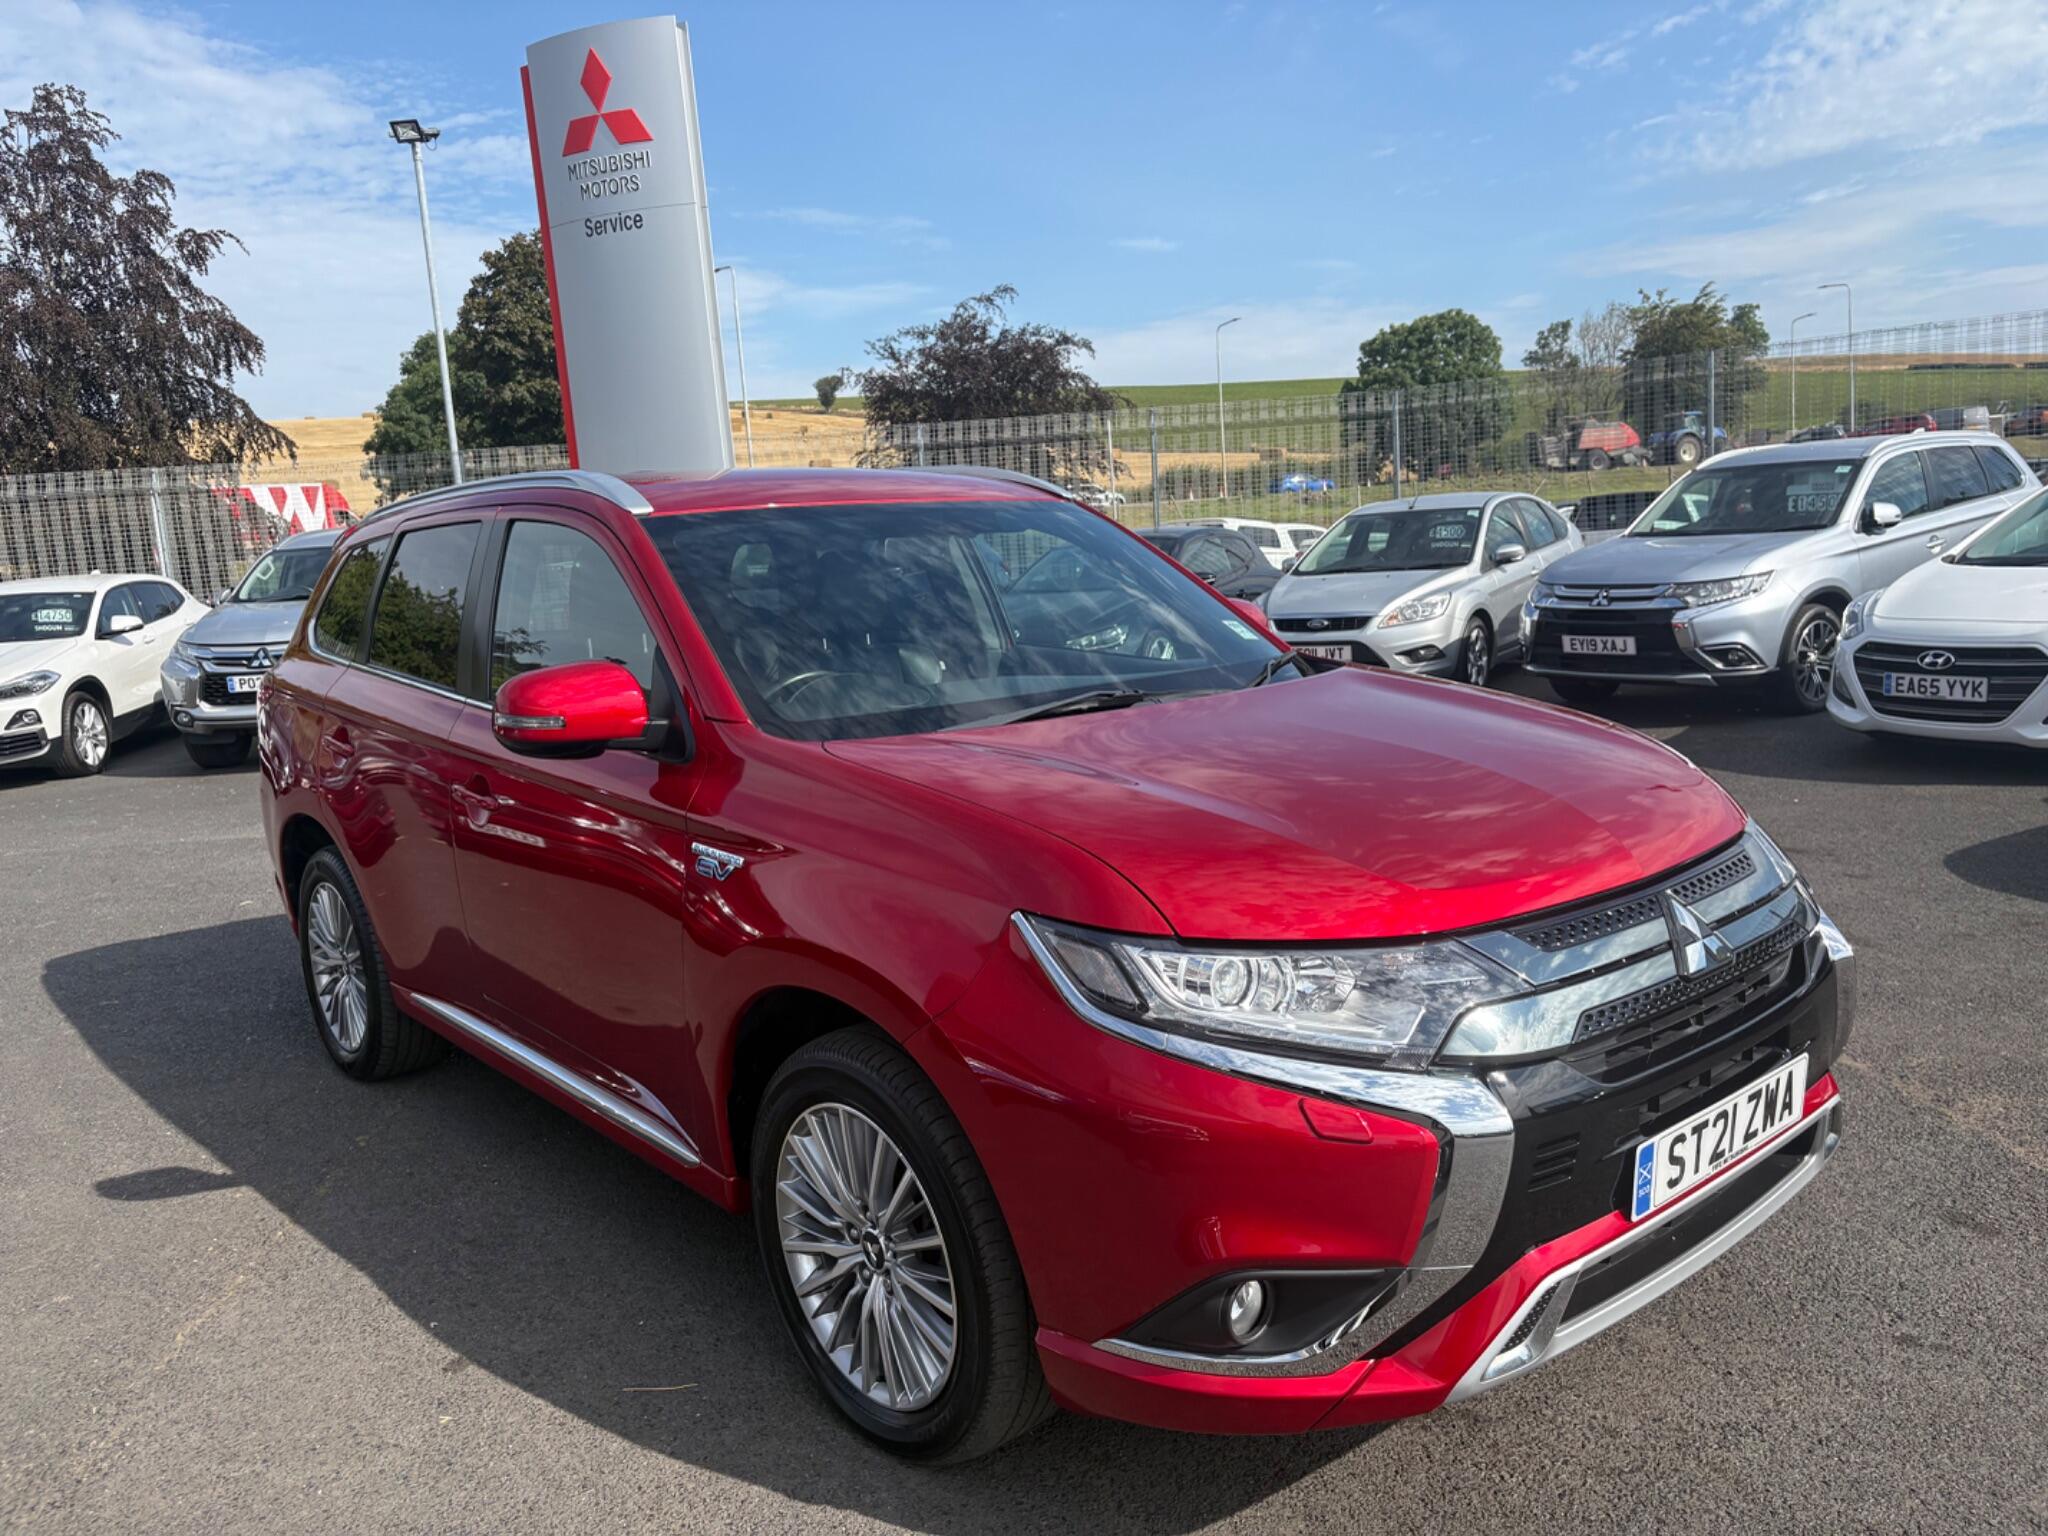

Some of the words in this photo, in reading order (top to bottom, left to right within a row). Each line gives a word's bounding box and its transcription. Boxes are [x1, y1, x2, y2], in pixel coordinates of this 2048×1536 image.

[567, 150, 652, 182] MITSUBISHI
[579, 174, 641, 200] MOTORS
[584, 211, 644, 238] Service
[1569, 637, 1598, 652] EY19
[1600, 639, 1628, 653] XAJ
[1895, 676, 1941, 696] EA65
[1946, 679, 1984, 698] YYK
[1666, 1102, 1738, 1190] ST21
[1742, 1070, 1794, 1145] ZWA
